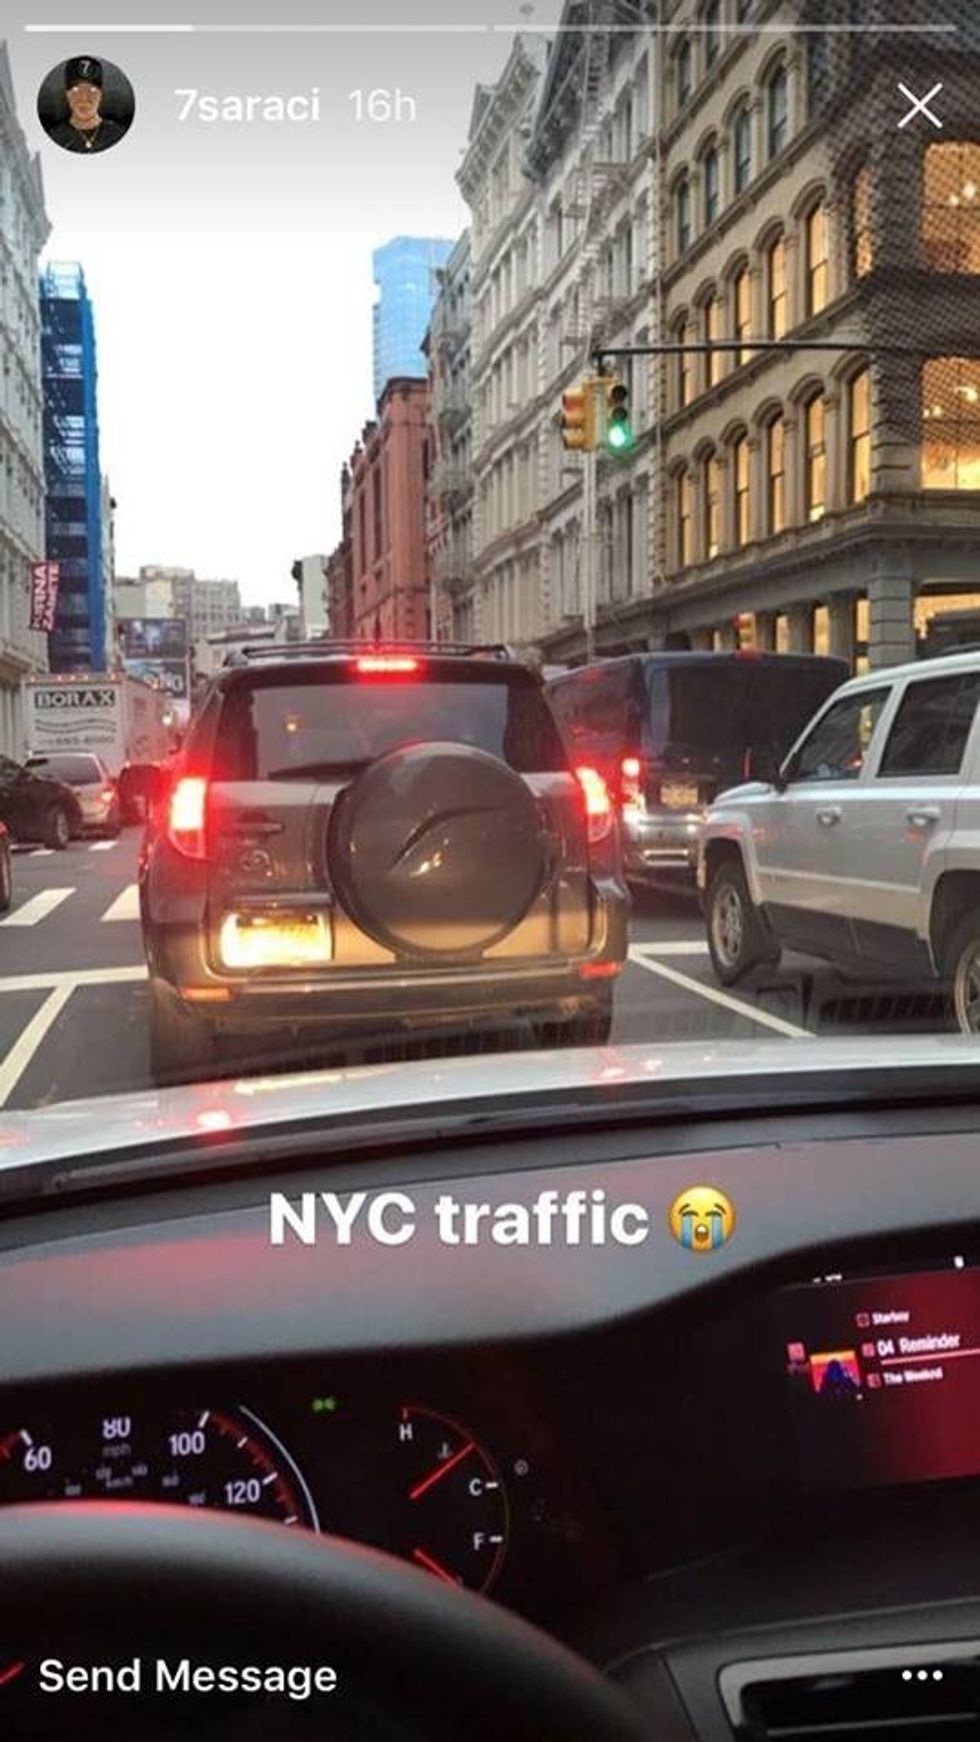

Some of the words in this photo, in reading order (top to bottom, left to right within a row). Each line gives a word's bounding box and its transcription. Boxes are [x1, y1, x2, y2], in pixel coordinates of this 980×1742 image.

[34, 689, 115, 708] BORAX
[877, 1339, 895, 1356] 04
[899, 1333, 960, 1354] Reminder
[169, 1432, 205, 1456] 100
[24, 1446, 51, 1472] 60
[225, 1479, 261, 1505] 120
[469, 1479, 482, 1496] C
[473, 1533, 484, 1550] F
